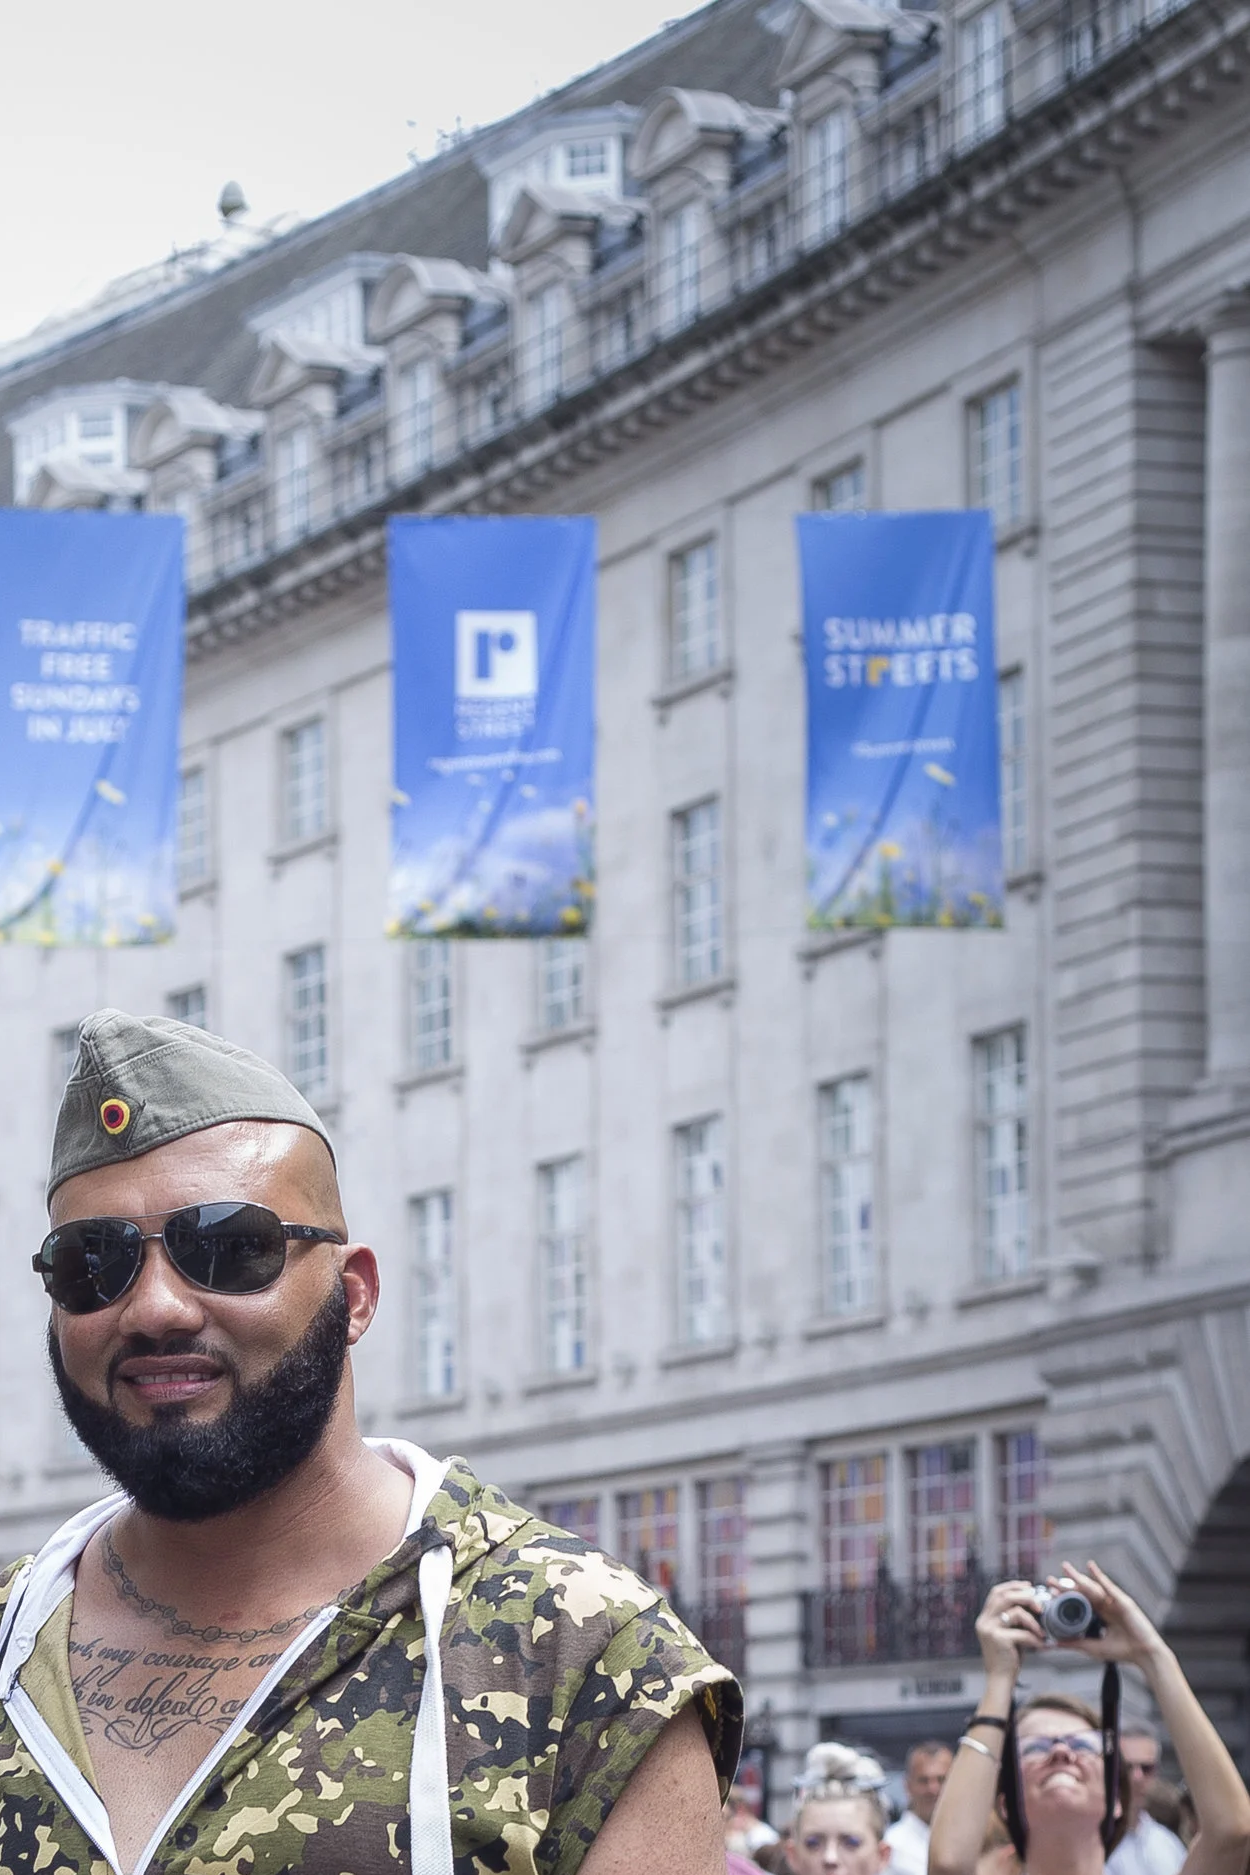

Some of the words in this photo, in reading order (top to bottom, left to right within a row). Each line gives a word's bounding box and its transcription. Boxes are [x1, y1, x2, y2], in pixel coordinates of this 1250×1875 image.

[18, 619, 138, 650] TRAFFIC
[823, 612, 977, 651] SUMMER
[40, 651, 113, 681] FREE
[9, 681, 141, 713] SUNDAYS
[27, 714, 62, 742] IN
[66, 713, 131, 744] JULY
[143, 1650, 248, 1695] courage
[125, 1672, 217, 1743] defeat
